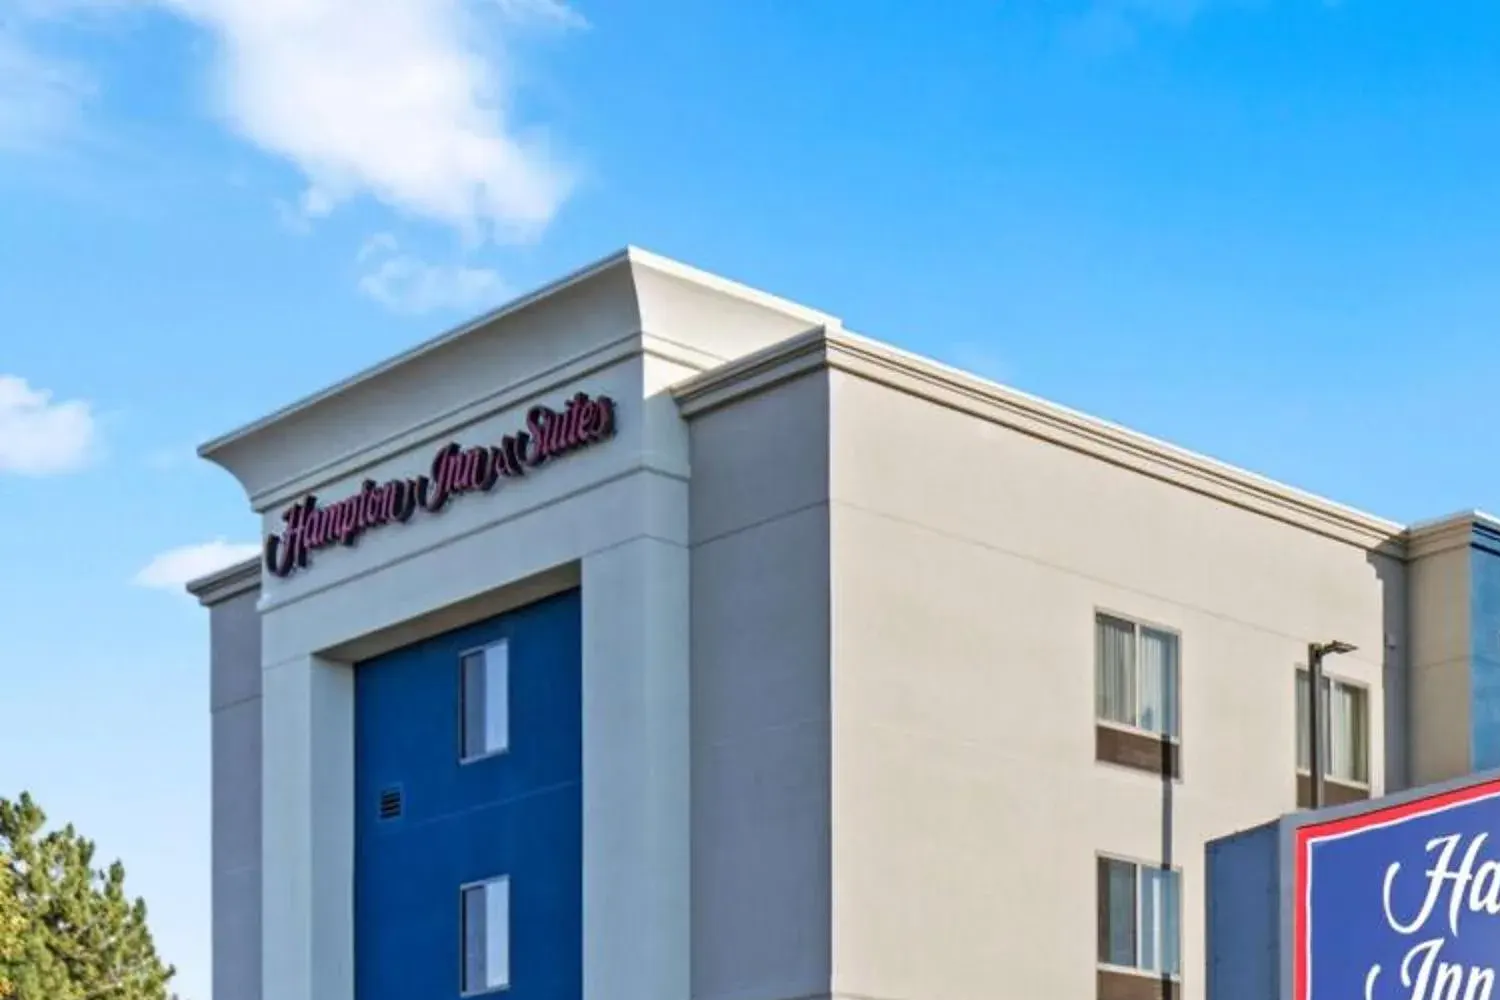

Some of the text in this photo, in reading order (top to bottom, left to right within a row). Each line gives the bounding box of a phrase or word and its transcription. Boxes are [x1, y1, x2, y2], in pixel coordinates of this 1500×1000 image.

[266, 478, 416, 577] Hampton
[415, 441, 500, 512] Inn
[515, 391, 616, 467] Suites
